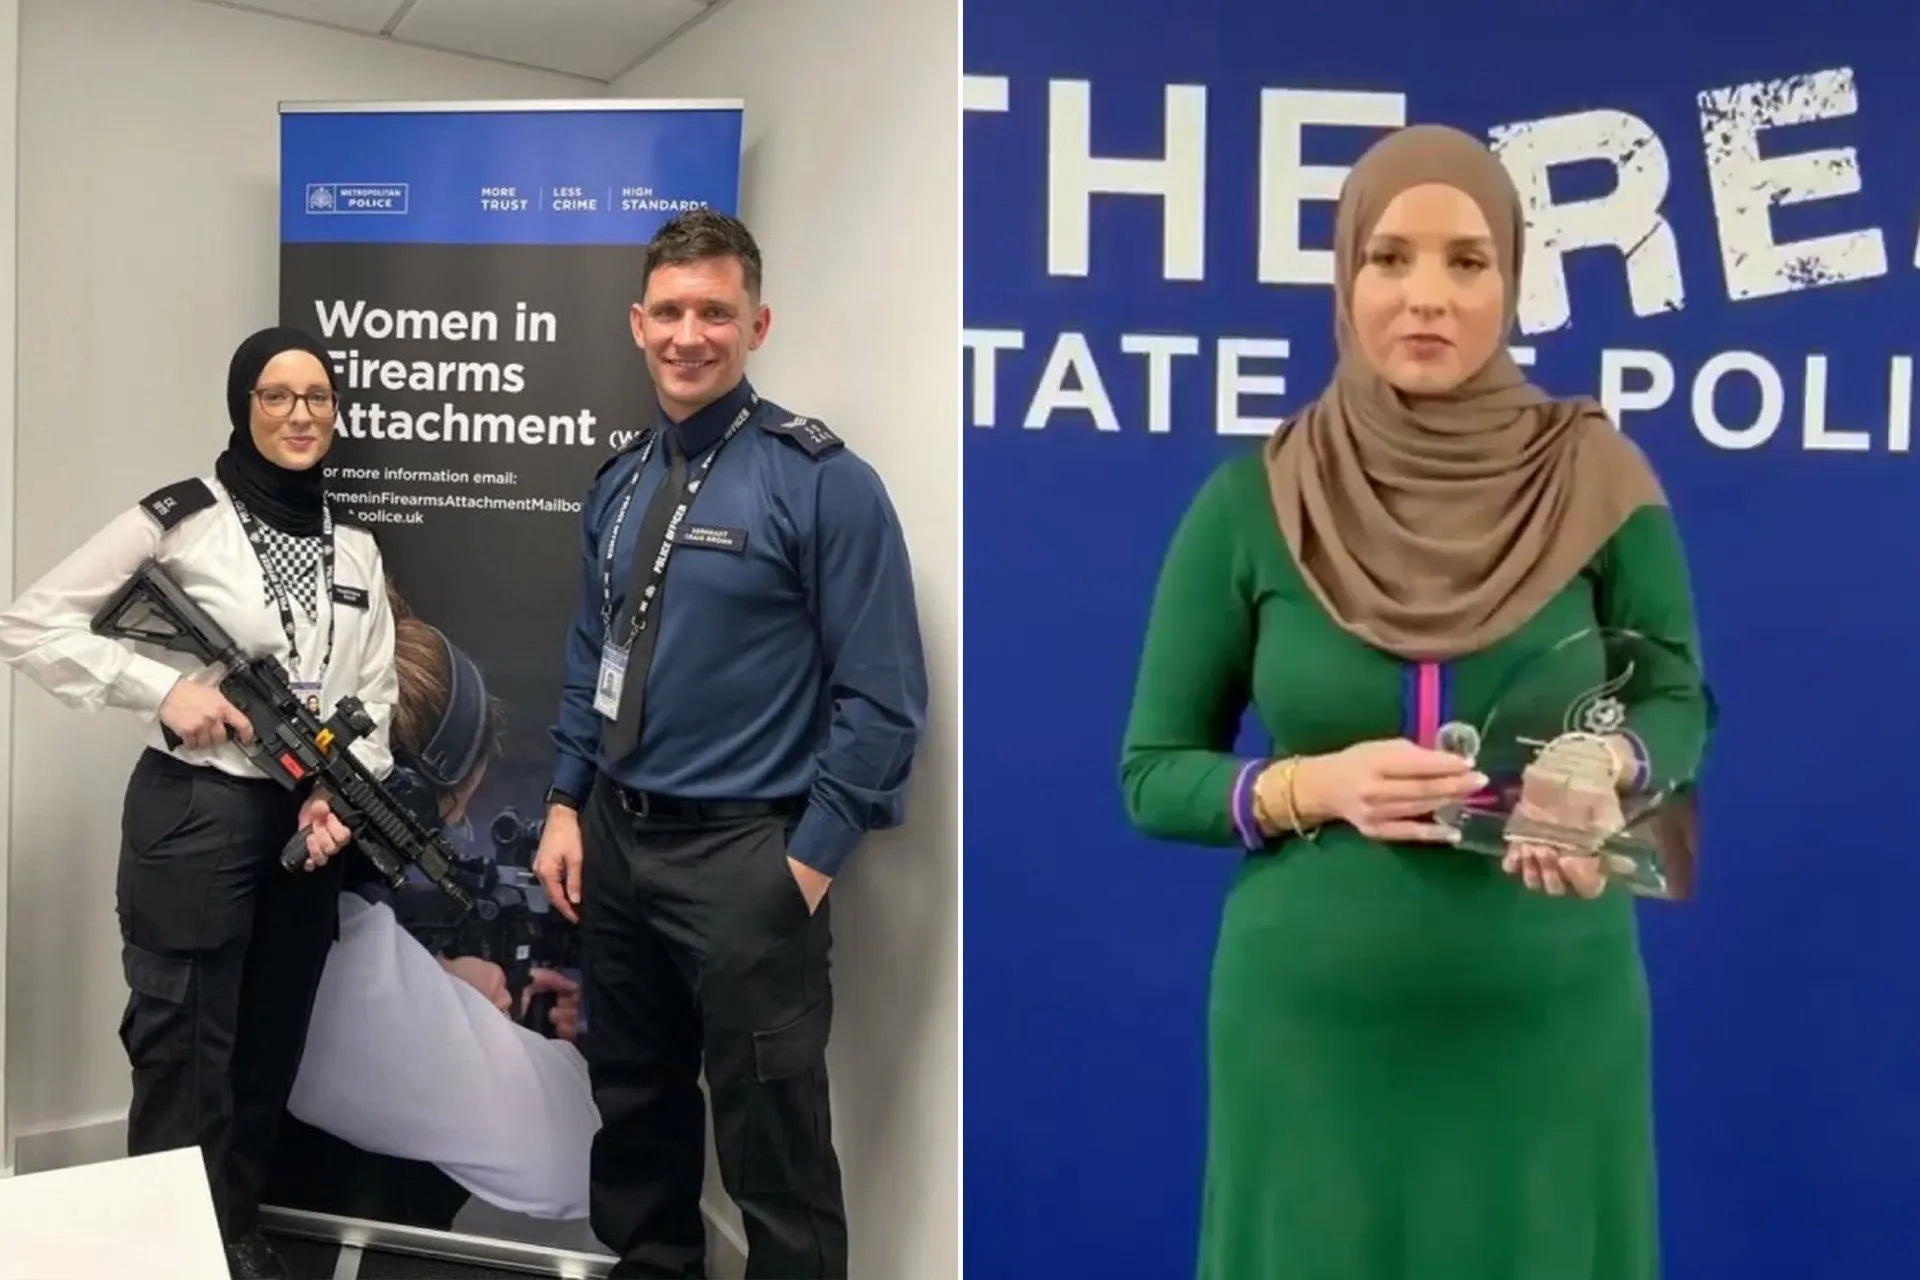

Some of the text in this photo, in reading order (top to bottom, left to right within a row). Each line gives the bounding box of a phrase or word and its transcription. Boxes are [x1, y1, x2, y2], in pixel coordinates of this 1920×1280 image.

[340, 187, 401, 197] METROPOLITAN
[481, 187, 516, 197] MORE
[553, 187, 583, 197] LESS
[622, 187, 653, 197] HIGH
[348, 198, 393, 208] POLICE
[481, 199, 528, 212] TRUST
[552, 199, 598, 212] CRIME
[963, 66, 1920, 336] HE RE
[314, 299, 557, 342] Women in
[323, 467, 518, 485] or more information email:
